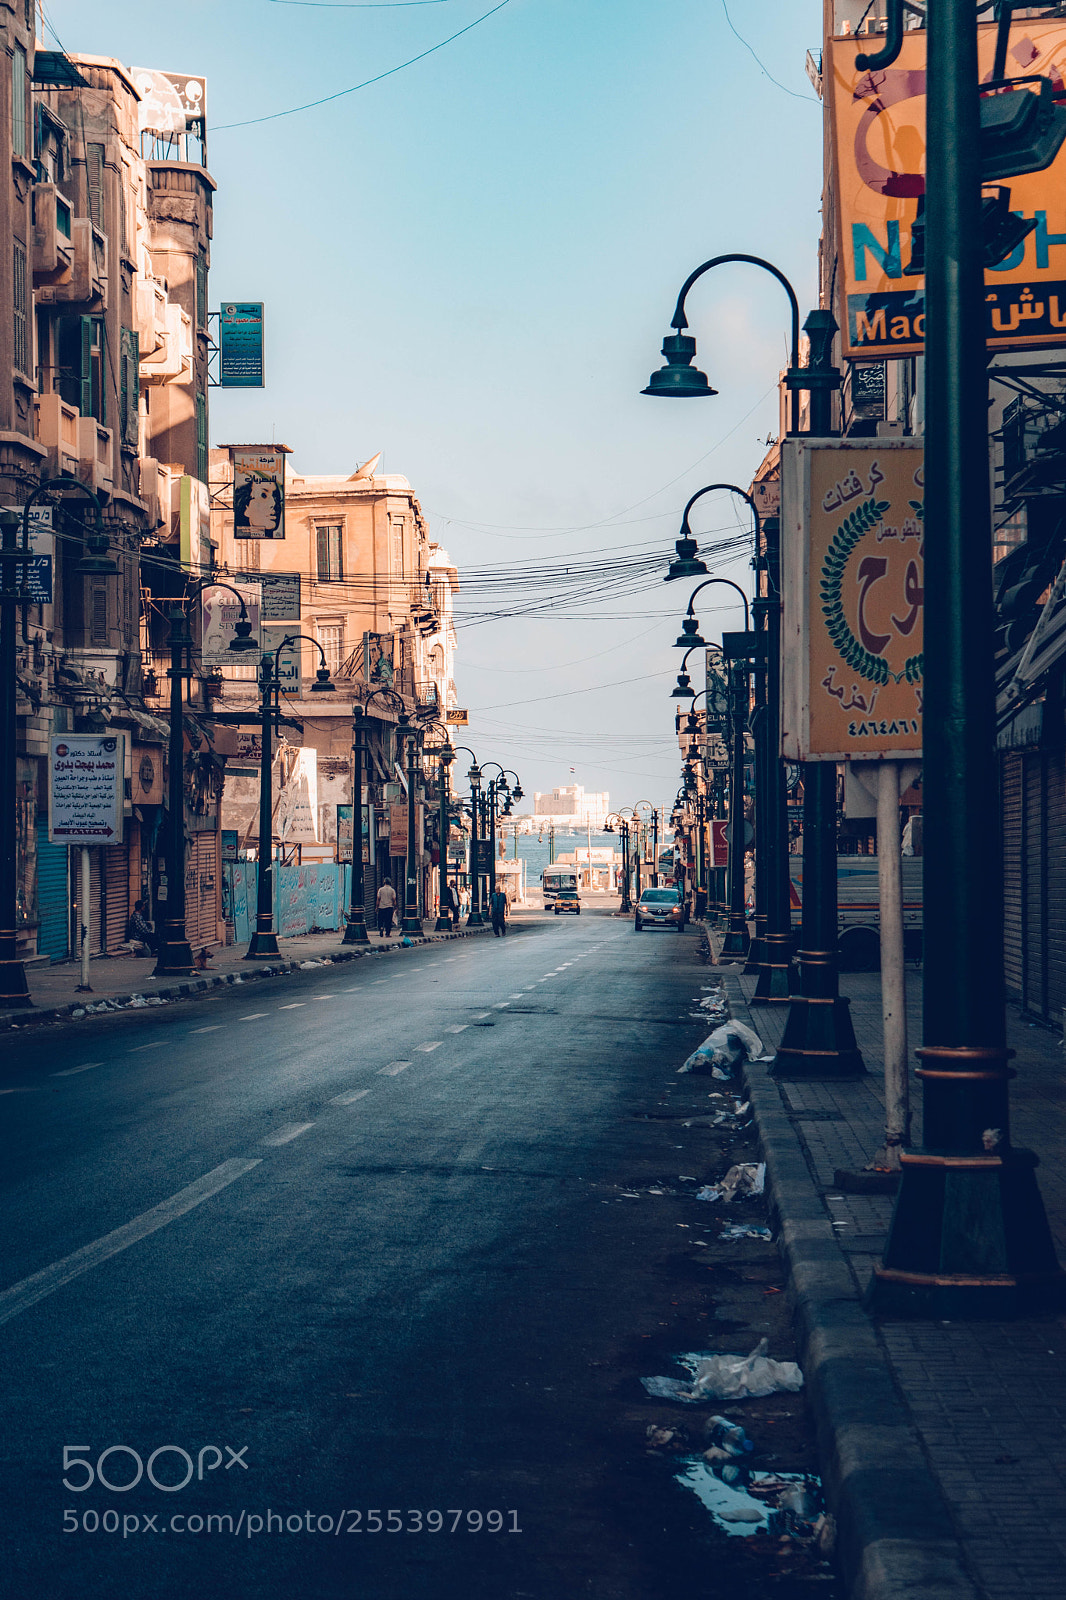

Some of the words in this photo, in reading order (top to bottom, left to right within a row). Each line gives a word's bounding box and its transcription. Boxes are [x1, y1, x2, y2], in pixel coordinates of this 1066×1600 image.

[237, 458, 282, 474] المستقبل
[258, 456, 275, 464] شركة
[822, 461, 884, 513] كرفتات
[218, 622, 237, 630] STY
[821, 666, 878, 715] أحزمة
[847, 719, 919, 737] ٤٨٦٤٨٦١
[54, 760, 74, 772] بدوى
[74, 759, 95, 772] بهجت
[95, 760, 115, 769] محمد
[54, 774, 69, 782] العيون
